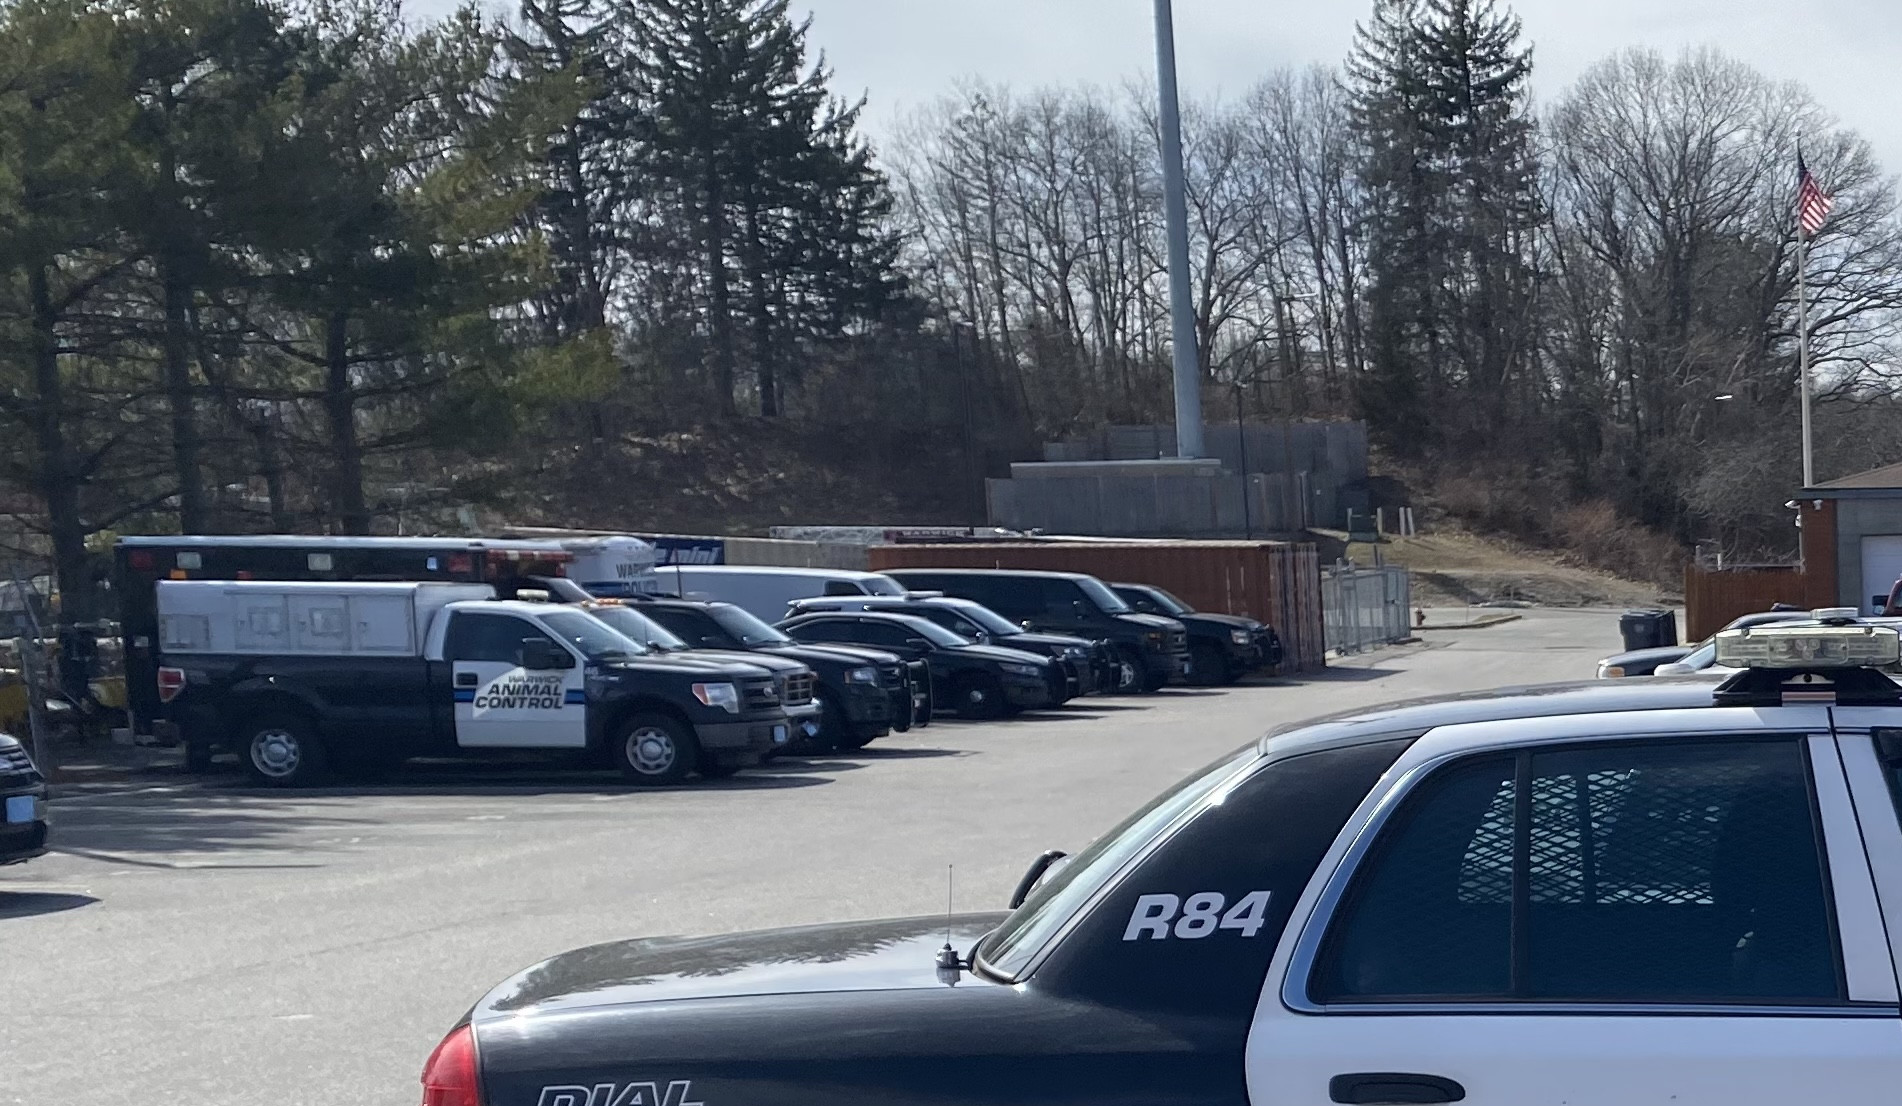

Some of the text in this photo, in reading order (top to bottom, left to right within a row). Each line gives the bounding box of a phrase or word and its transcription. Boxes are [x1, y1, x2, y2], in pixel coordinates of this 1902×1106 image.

[508, 675, 564, 684] WARWICK
[487, 683, 562, 696] ANIMAL
[475, 696, 563, 709] CONTROL
[1122, 890, 1272, 941] R84
